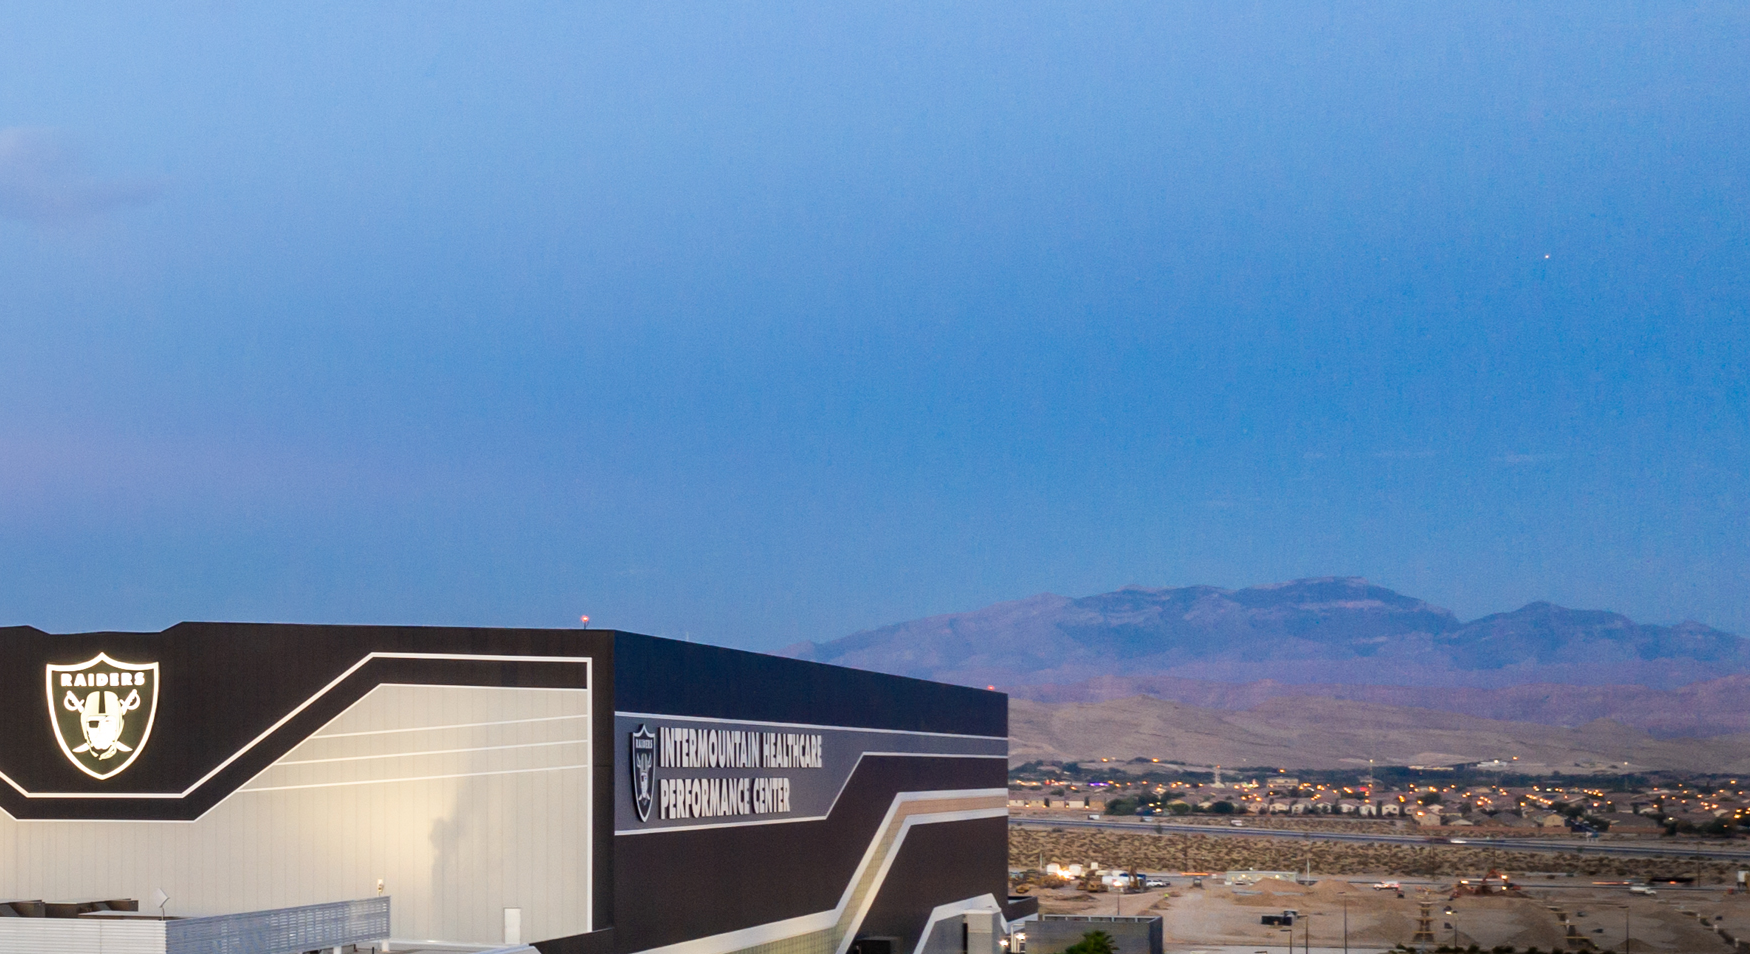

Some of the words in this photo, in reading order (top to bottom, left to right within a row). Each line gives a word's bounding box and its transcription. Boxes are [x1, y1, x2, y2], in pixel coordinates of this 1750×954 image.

[61, 672, 145, 687] RAIDERS
[659, 727, 760, 768] INTERMOUNTAIN
[763, 732, 822, 768] HEALTHCARE
[660, 778, 750, 819] PERFORMANCE
[753, 777, 791, 814] CENTER
